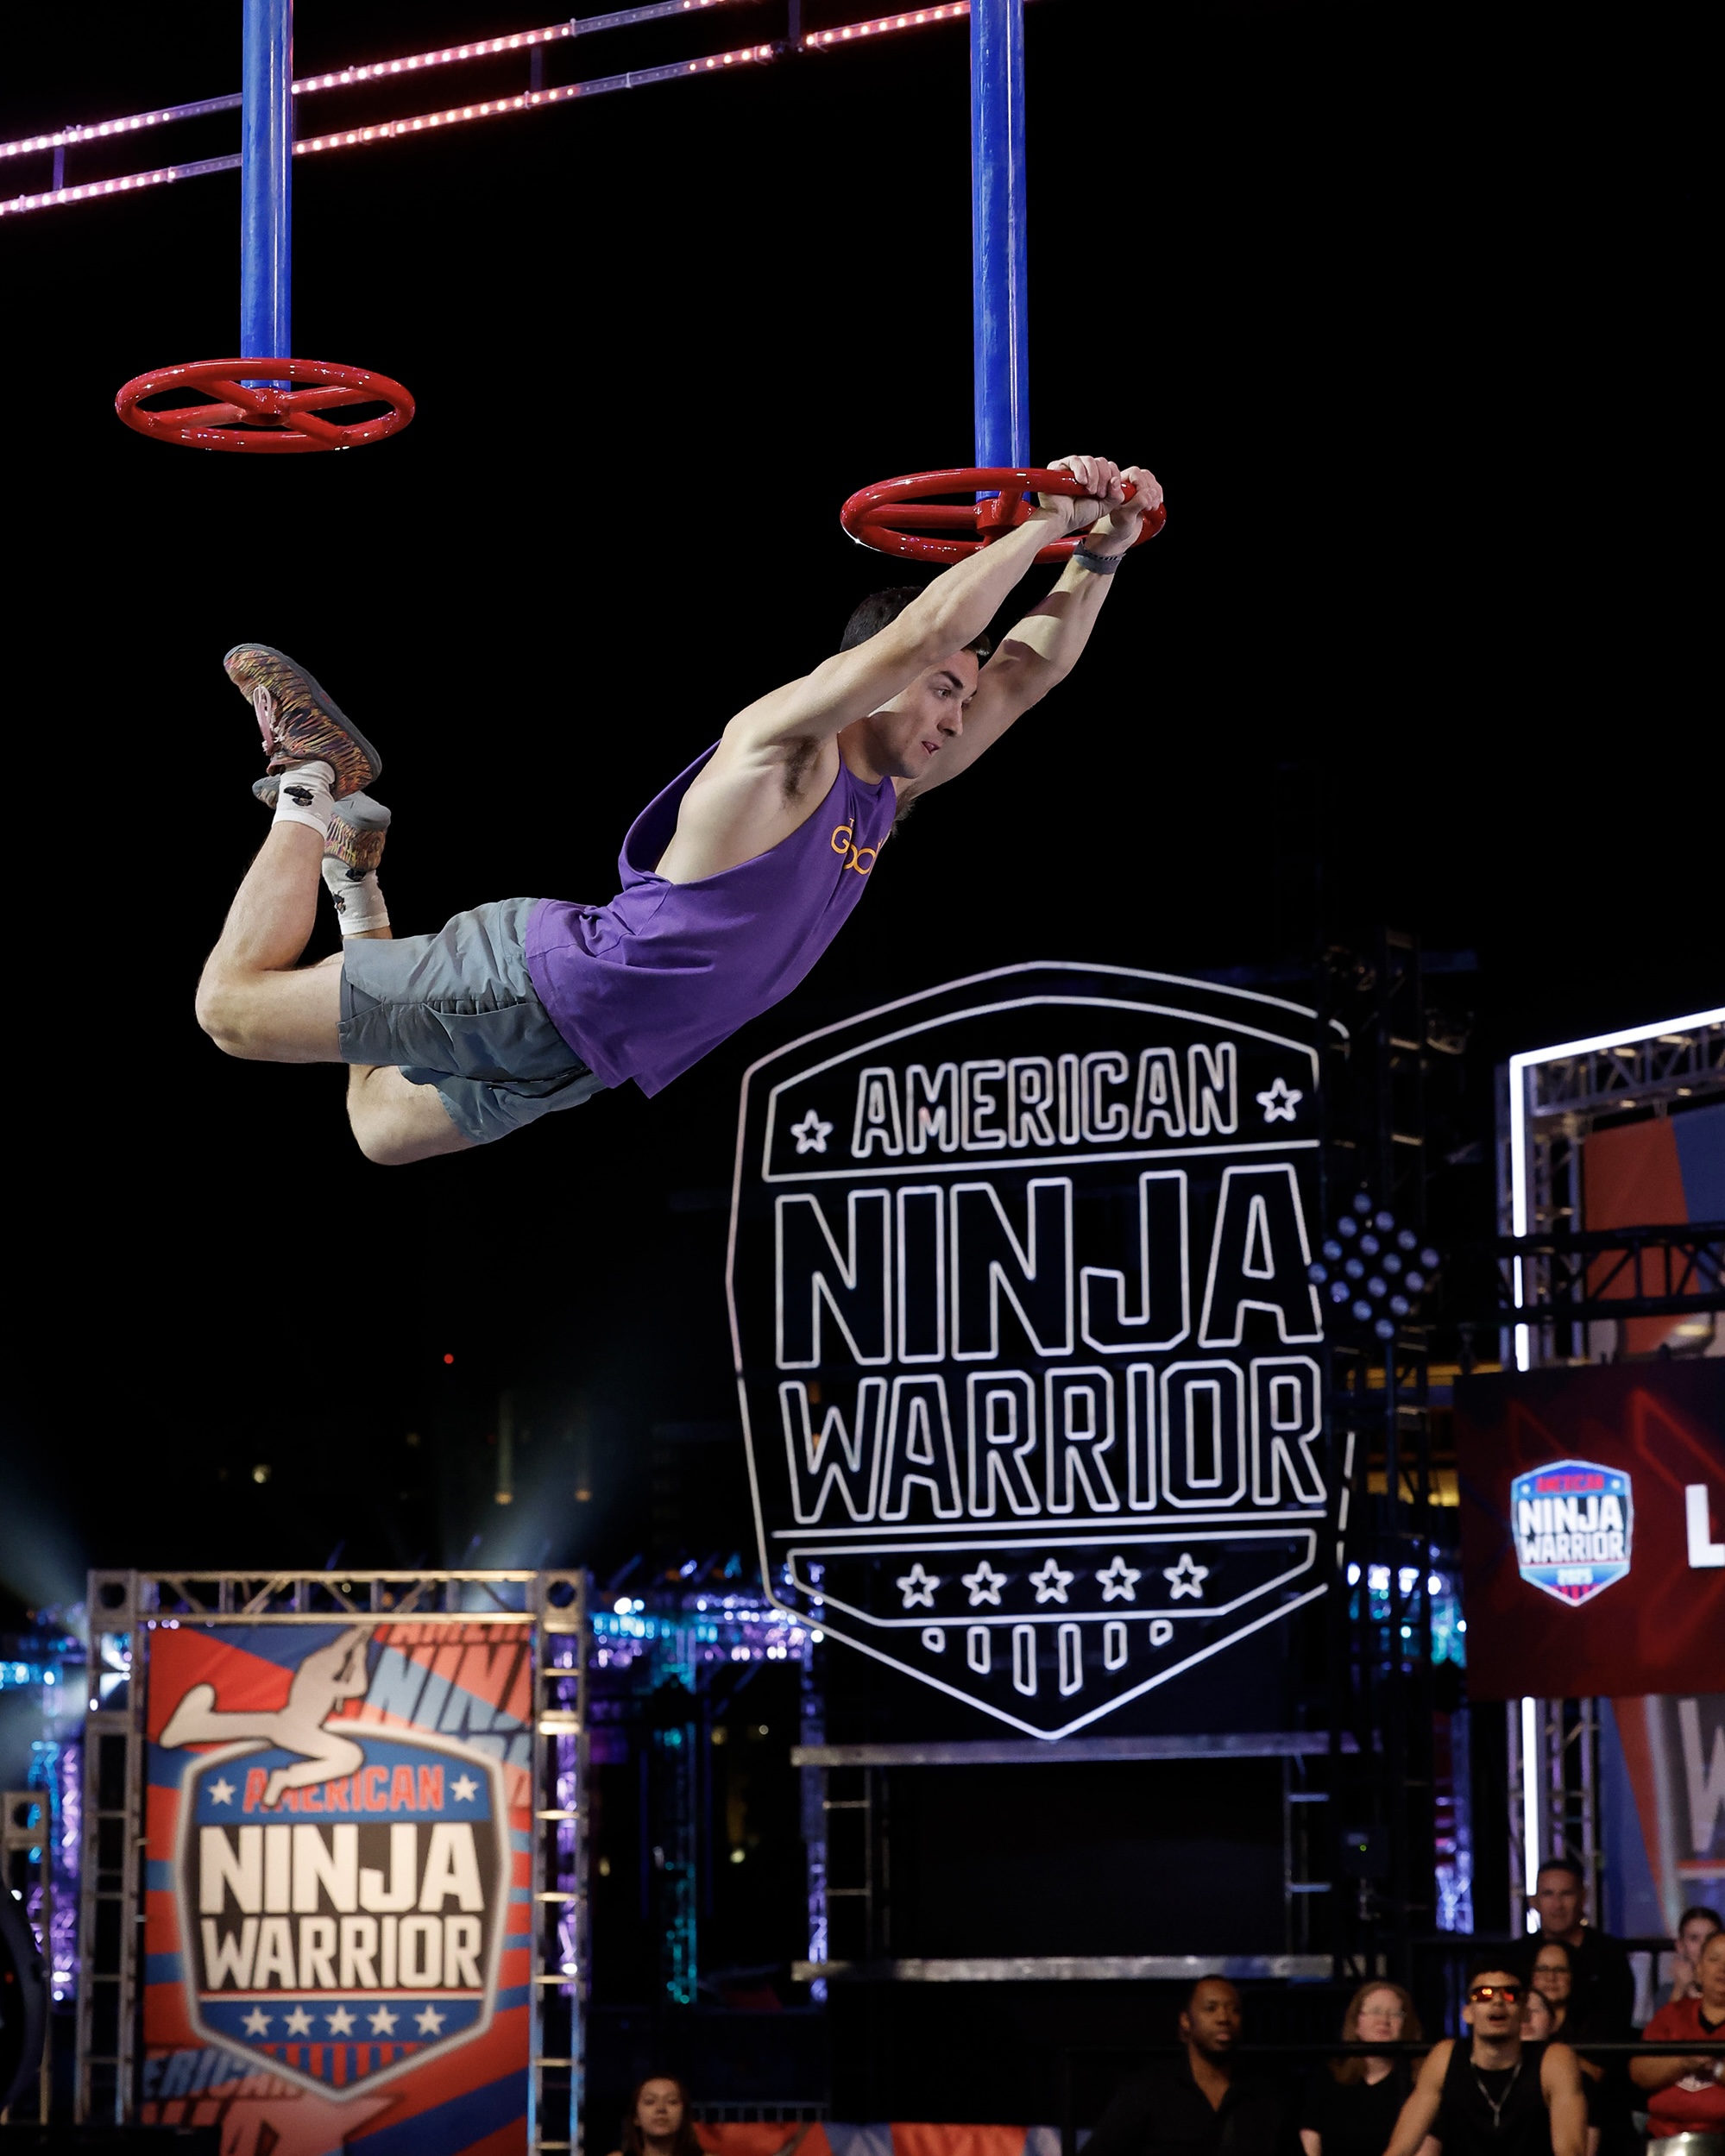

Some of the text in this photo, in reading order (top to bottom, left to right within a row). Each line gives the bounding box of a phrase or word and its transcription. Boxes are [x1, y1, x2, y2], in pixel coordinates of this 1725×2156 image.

[852, 1042, 1237, 1158] AMERICAN
[775, 1163, 1324, 1370] NINJA
[778, 1355, 1327, 1525] WARRIOR
[1518, 1495, 1624, 1536] NINJA
[1520, 1531, 1624, 1563] WARRIOR
[198, 1822, 485, 1914] NINJA
[201, 1914, 483, 1991] WARRIOR
